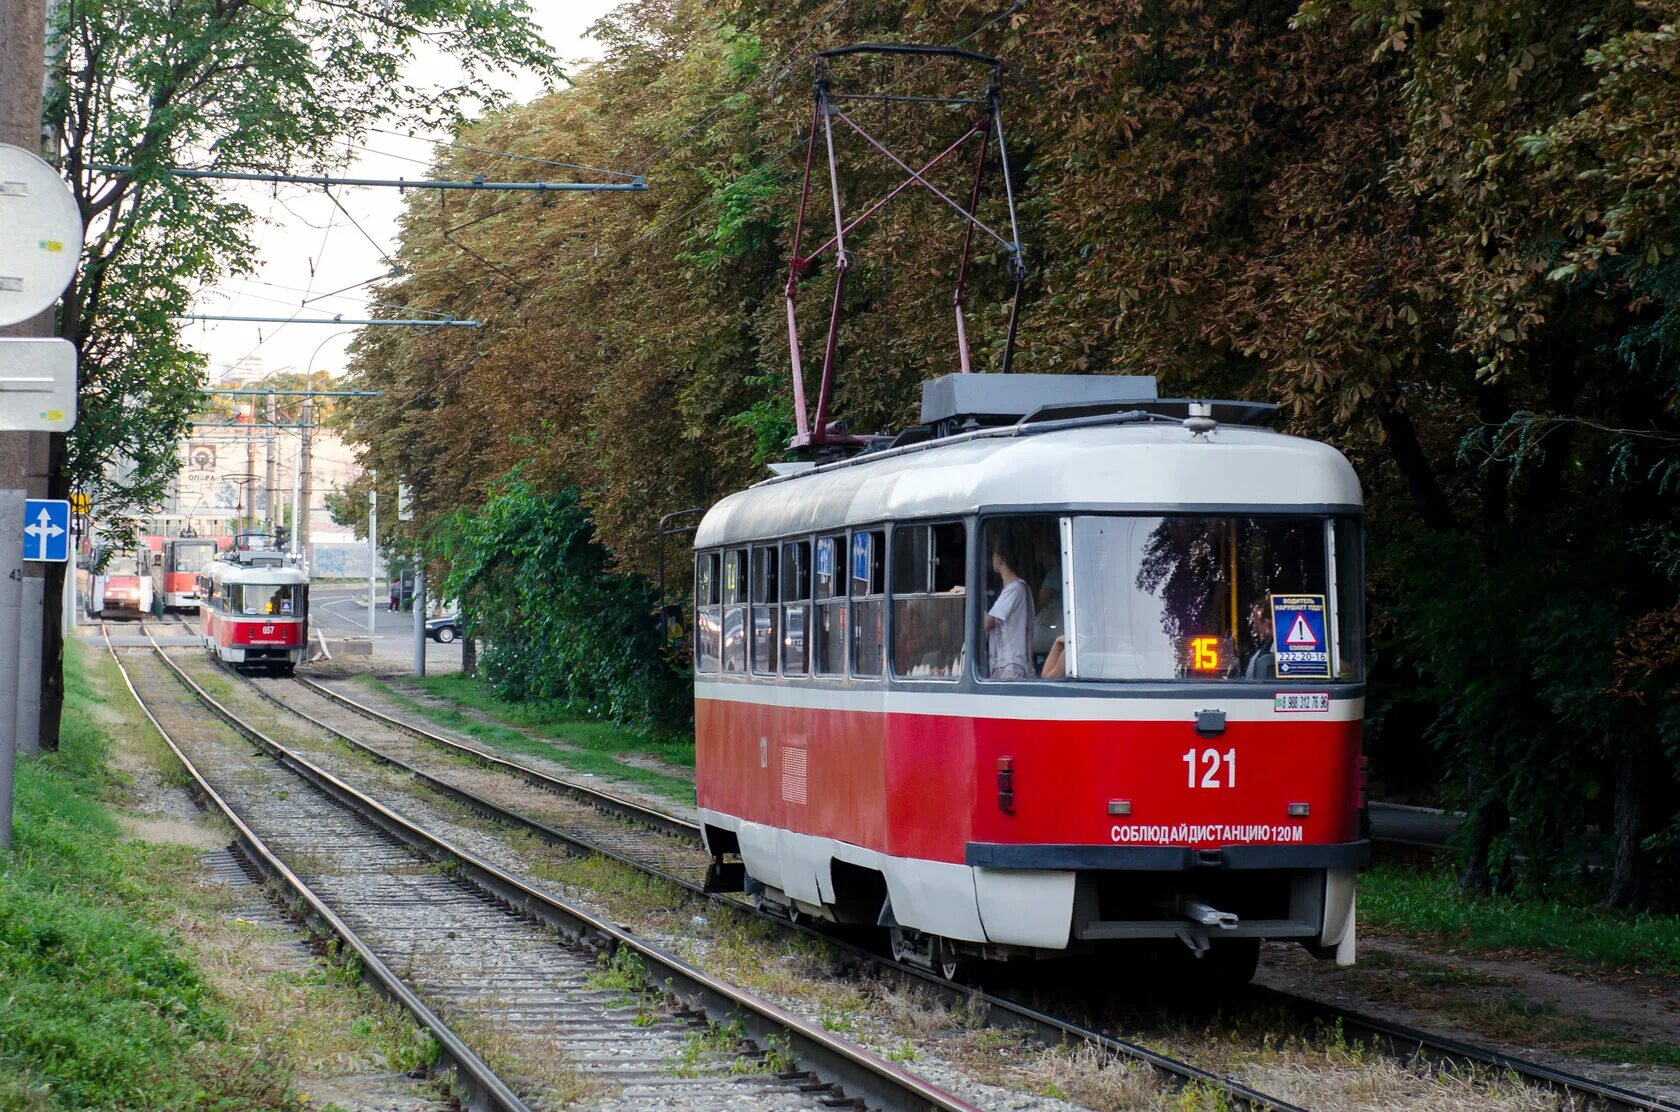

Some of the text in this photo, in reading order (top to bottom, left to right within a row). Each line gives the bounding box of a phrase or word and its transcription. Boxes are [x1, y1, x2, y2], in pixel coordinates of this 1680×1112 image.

[1191, 638, 1218, 669] 15
[1279, 652, 1326, 661] 222-20-16
[1182, 747, 1237, 789] 121
